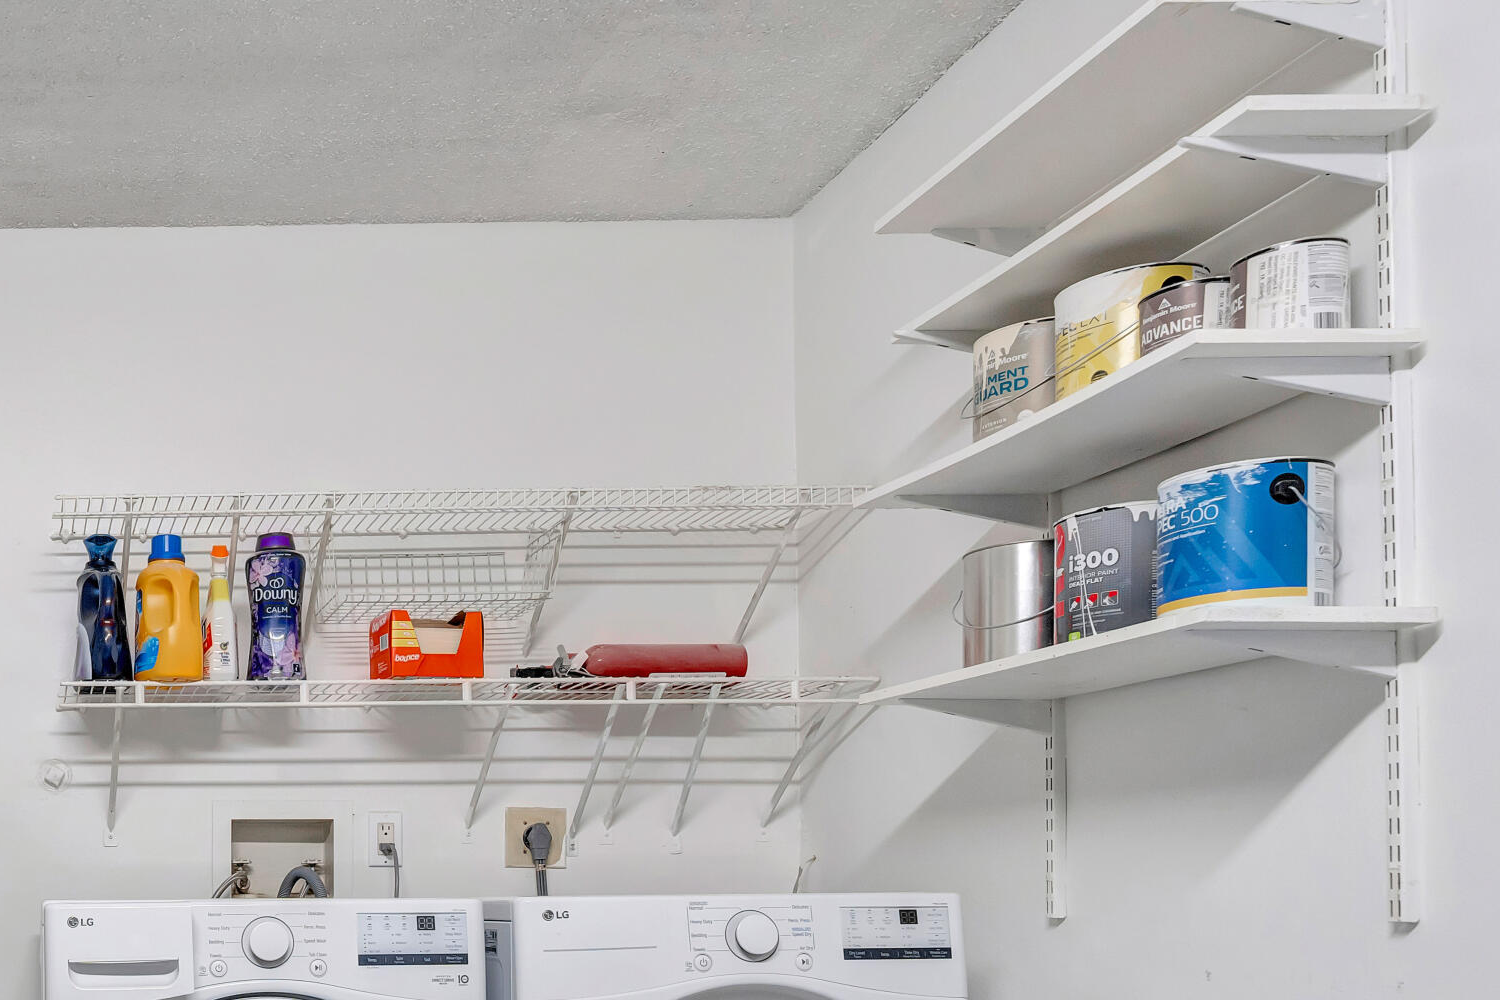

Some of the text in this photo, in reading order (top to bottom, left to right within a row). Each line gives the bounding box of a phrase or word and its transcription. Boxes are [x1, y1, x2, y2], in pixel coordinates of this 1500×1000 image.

[1141, 314, 1204, 348] ADVANCE
[1180, 504, 1219, 527] 500
[1068, 547, 1120, 574] i300
[1086, 576, 1105, 585] FLAT
[255, 588, 298, 605] Downy
[266, 606, 289, 614] CALM
[394, 653, 420, 663] bounce
